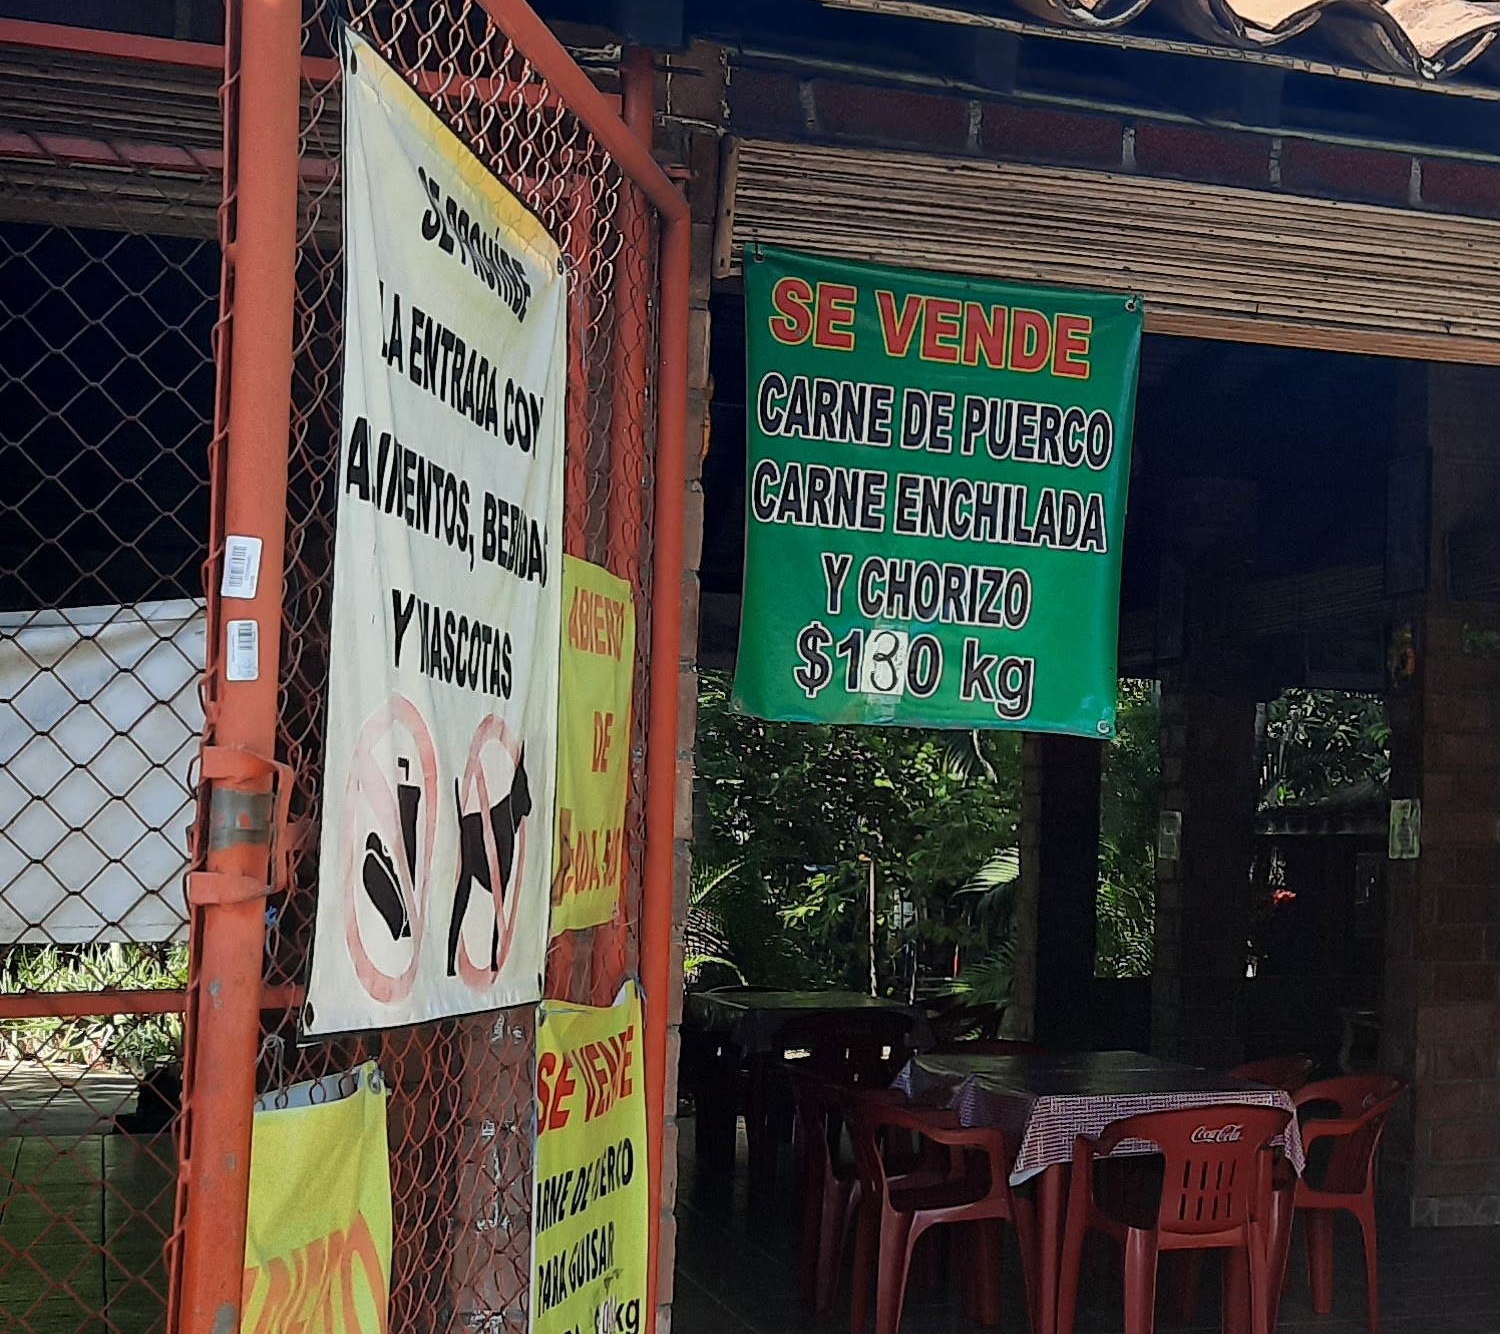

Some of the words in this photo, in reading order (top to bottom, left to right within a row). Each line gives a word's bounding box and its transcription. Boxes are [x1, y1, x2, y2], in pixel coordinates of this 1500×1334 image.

[379, 277, 403, 374] LA
[409, 305, 498, 438] ENTRADA
[768, 277, 857, 351] SE
[875, 289, 1092, 379] VENDE
[757, 373, 894, 447] CARNE
[900, 388, 956, 453] DE
[961, 397, 1113, 470] PUERCO
[751, 460, 887, 532] CARNE
[893, 473, 1108, 553] ENCHILADA
[821, 552, 853, 614] Y
[859, 557, 1031, 629] CHORIZO
[392, 588, 415, 668] Y
[417, 598, 512, 700] MASCOTAS
[793, 620, 943, 697] $130
[959, 638, 1035, 719] kg
[592, 711, 613, 772] DE
[537, 1051, 576, 1137] SE
[537, 1250, 567, 1318] PARA
[568, 1221, 614, 1294] GUISAR
